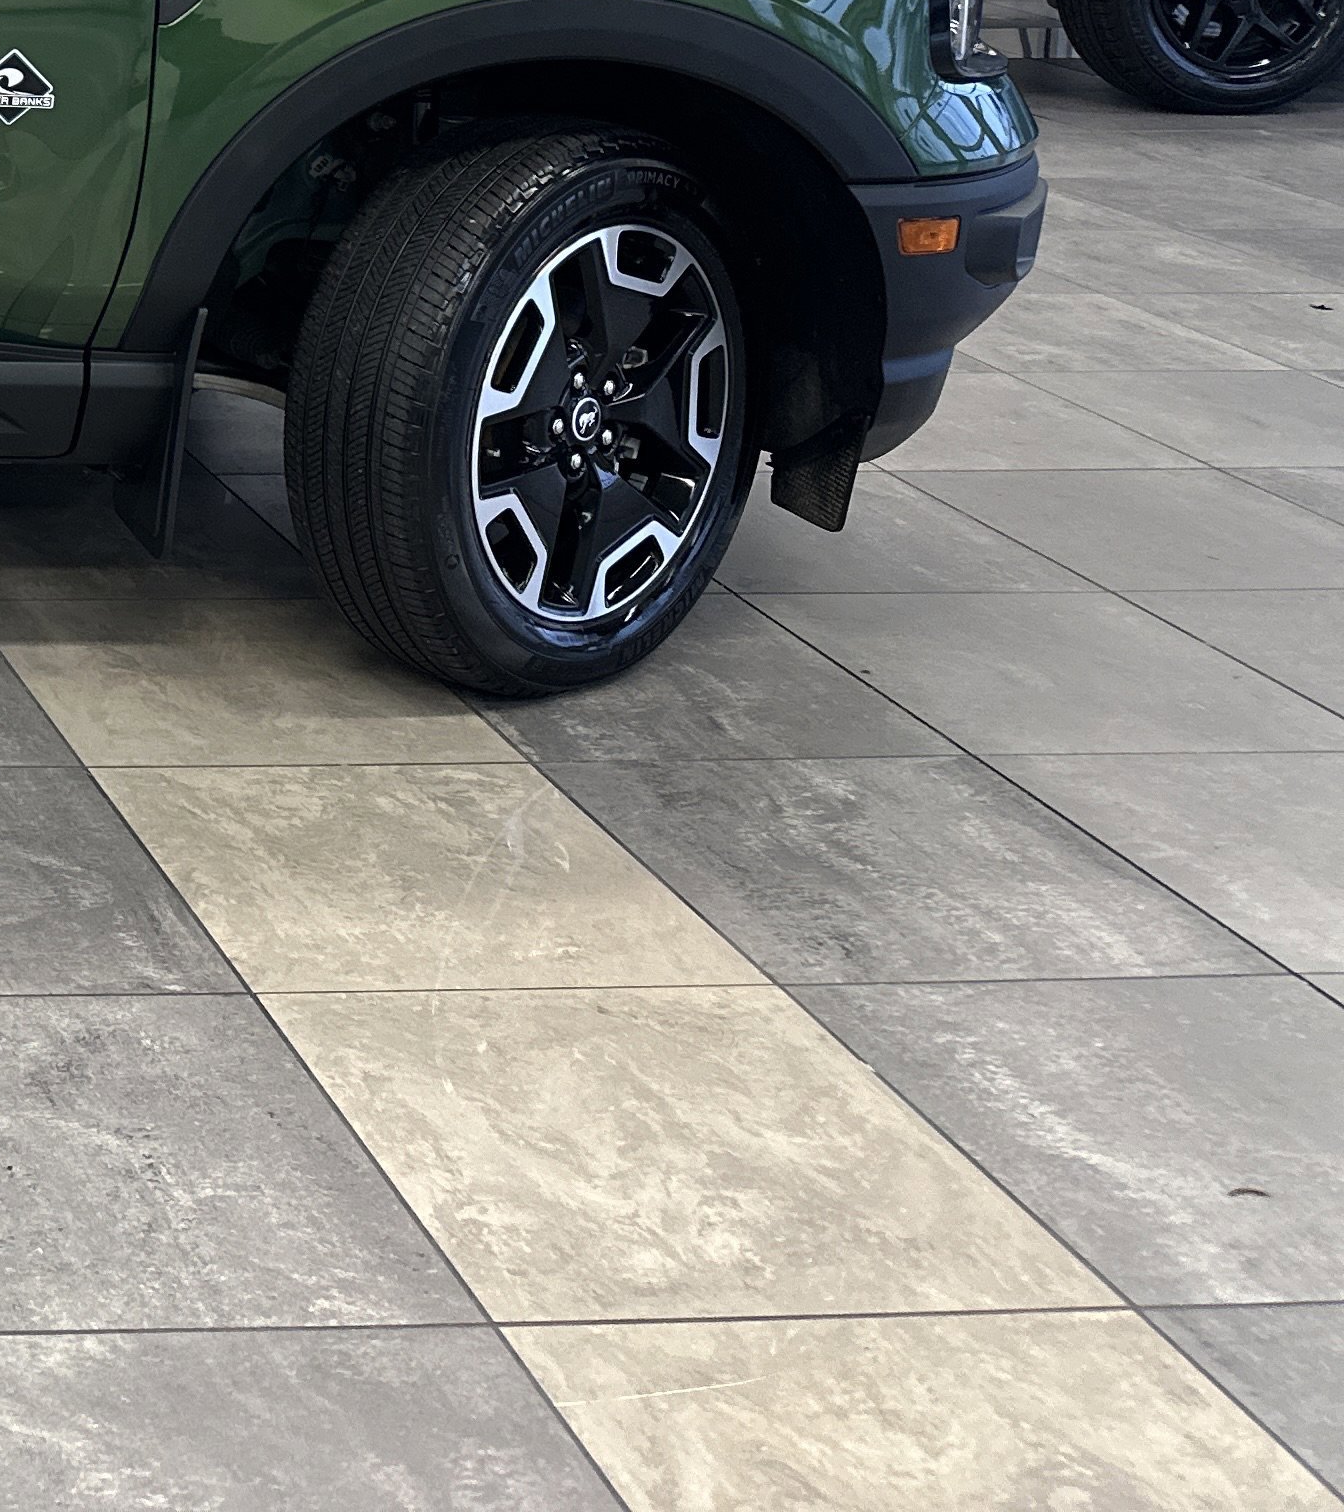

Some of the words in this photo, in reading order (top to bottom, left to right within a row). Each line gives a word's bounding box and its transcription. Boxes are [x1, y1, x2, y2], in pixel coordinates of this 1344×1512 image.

[11, 96, 52, 107] BANKS
[626, 170, 681, 189] PRIMACY
[513, 176, 613, 266] MICHELIN
